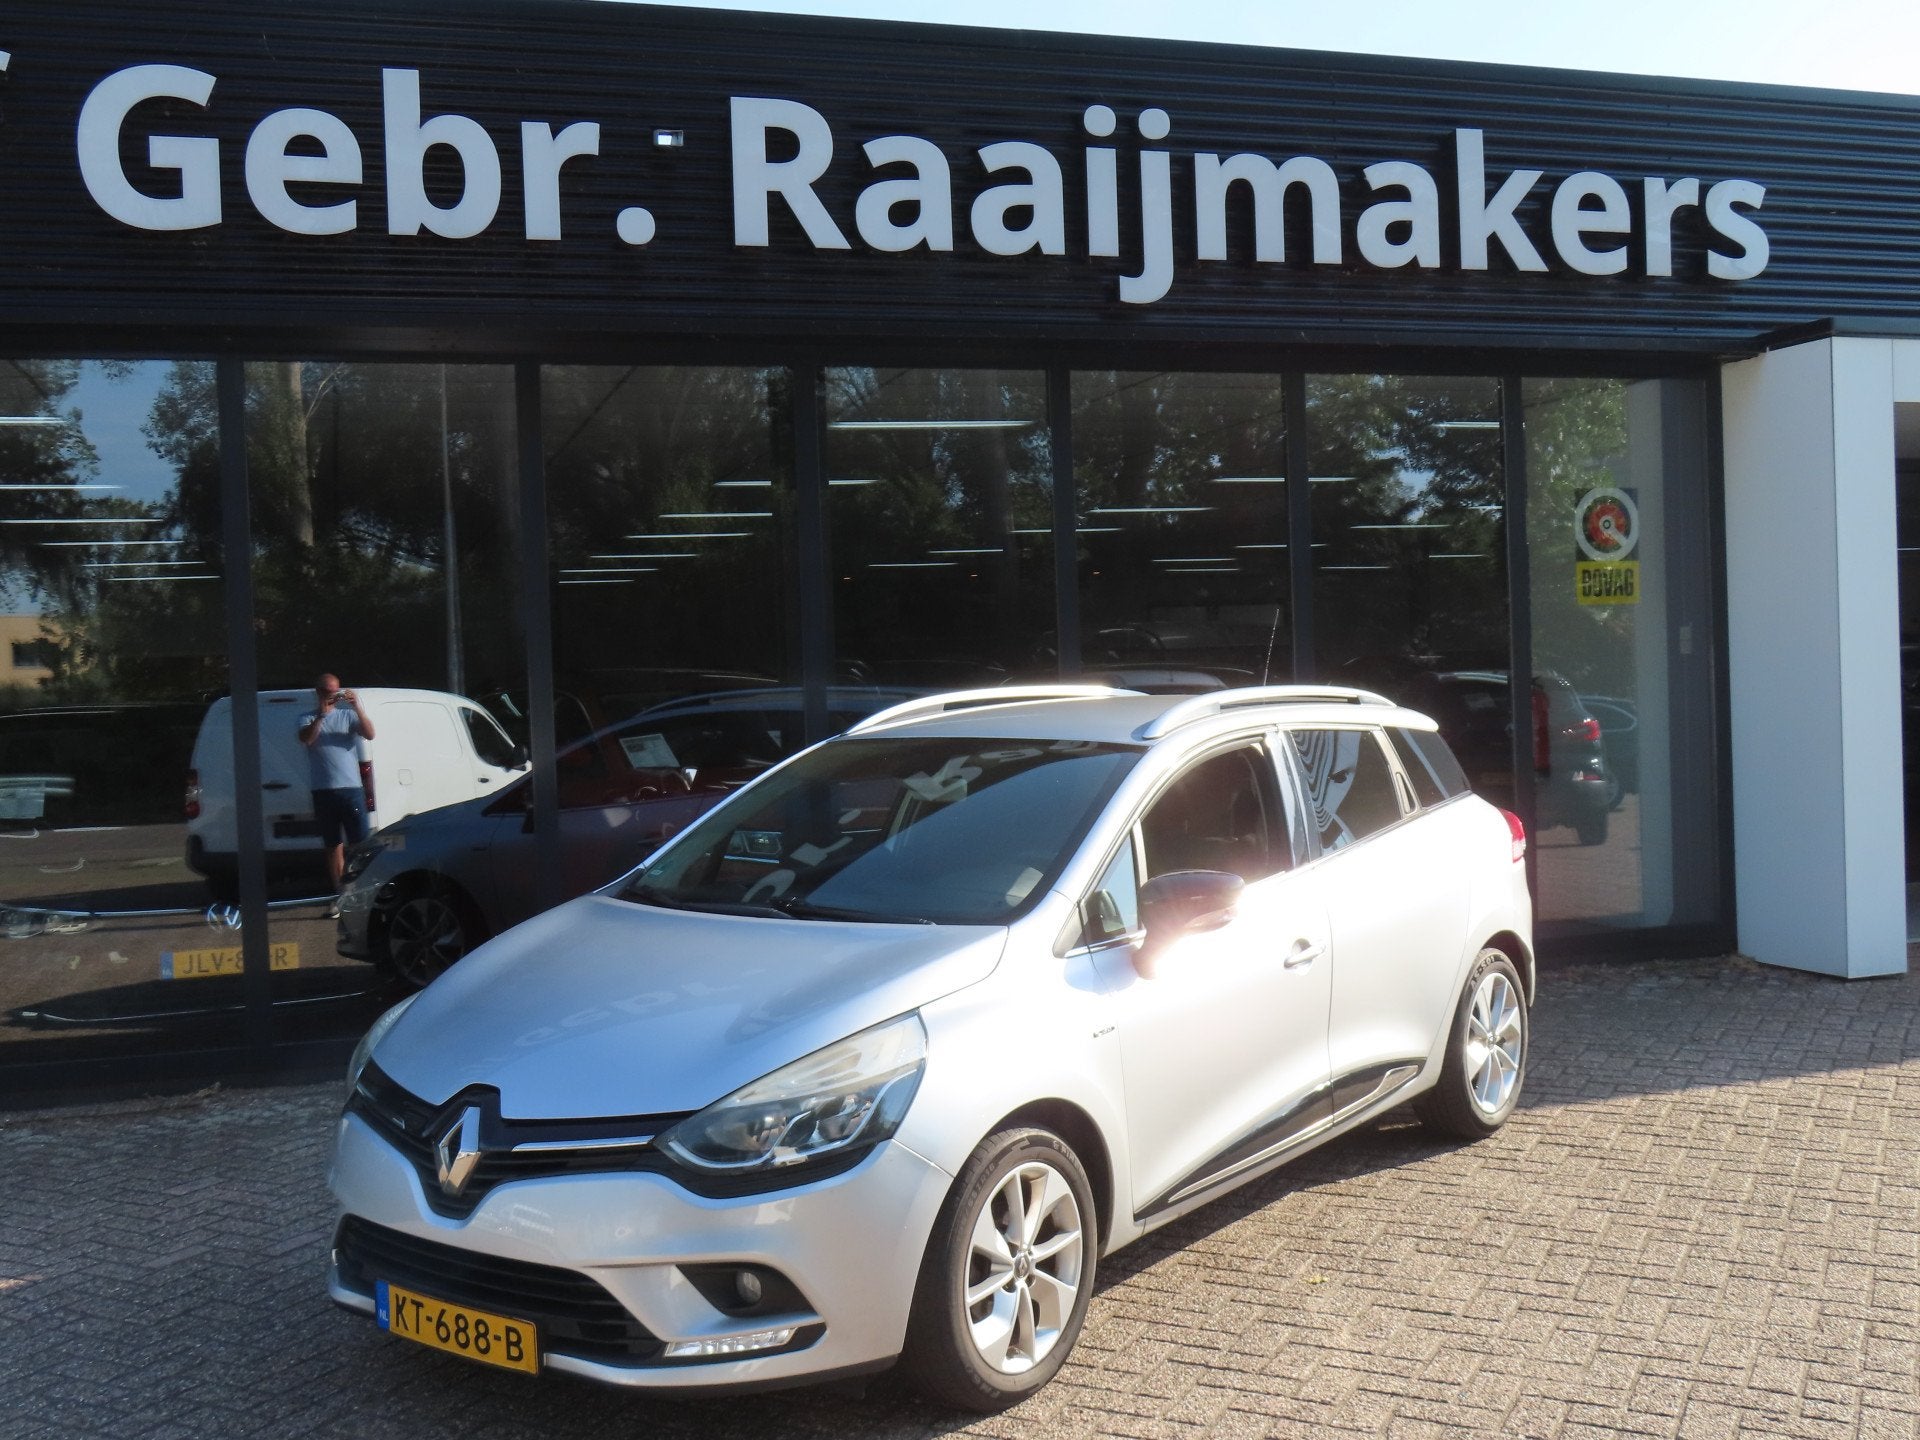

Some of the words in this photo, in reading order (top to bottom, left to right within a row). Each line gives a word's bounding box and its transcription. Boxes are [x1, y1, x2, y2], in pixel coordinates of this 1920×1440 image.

[77, 64, 655, 245] Gebr.
[730, 96, 1770, 304] Raaijmakers
[1583, 569, 1634, 597] BOVAG
[395, 1293, 524, 1362] KT-688-B
